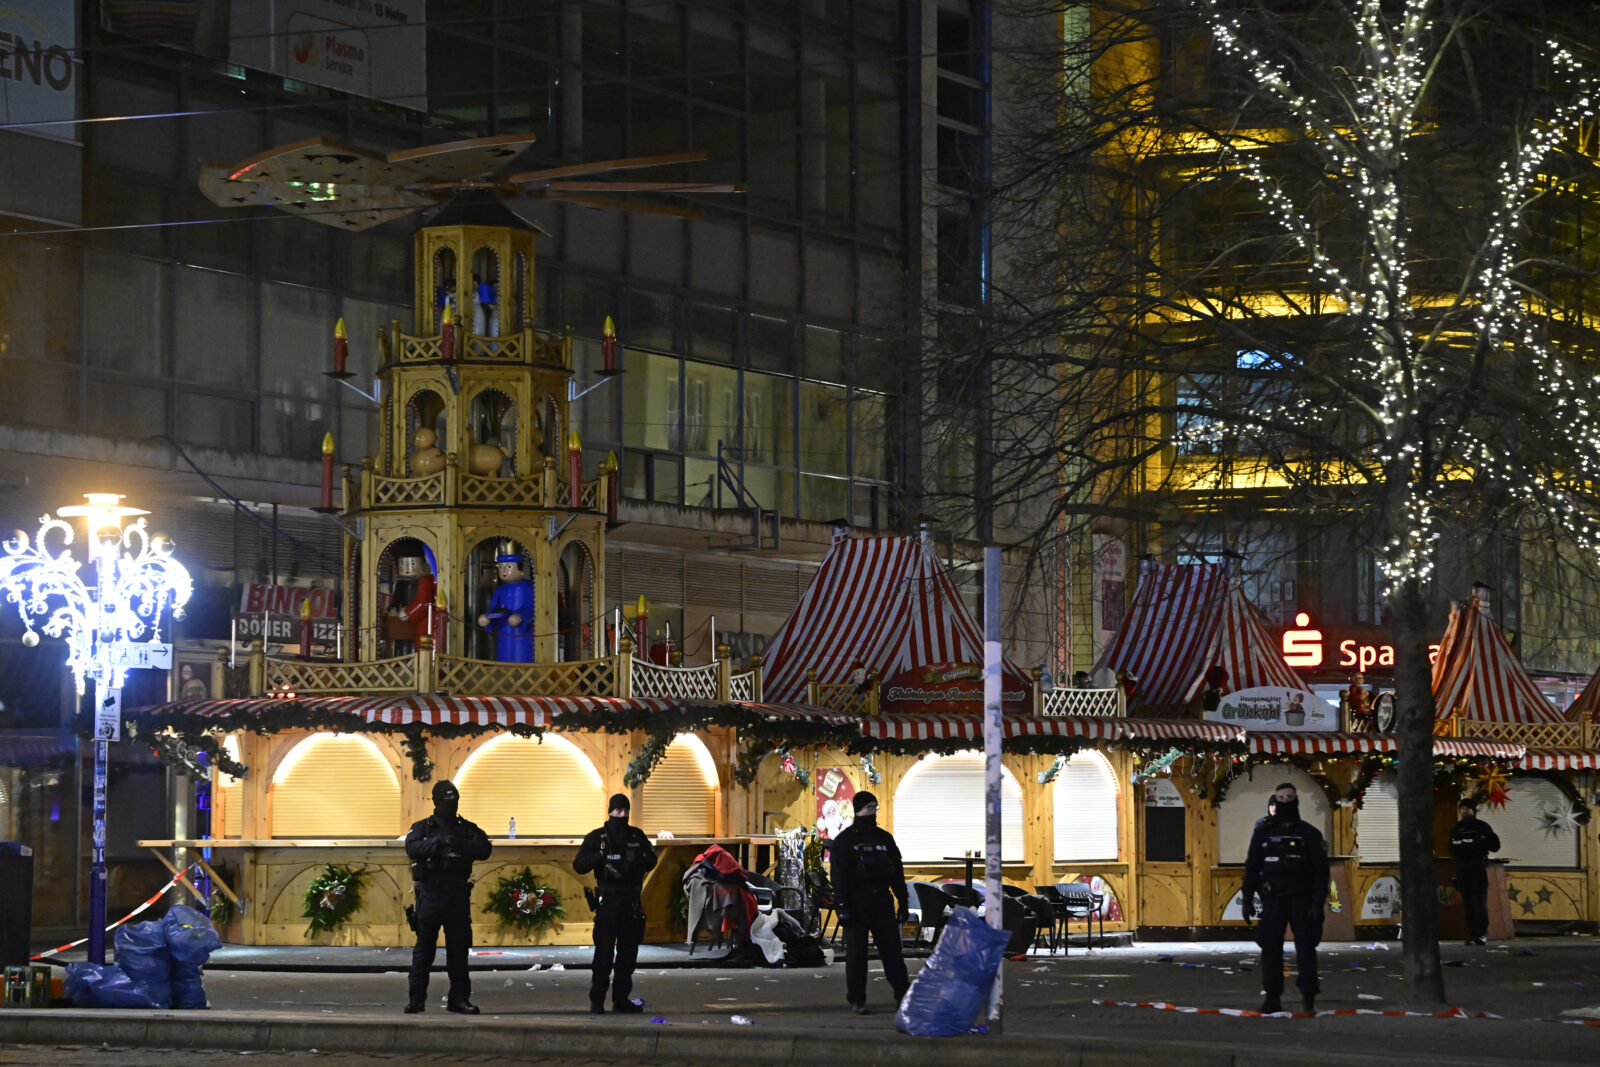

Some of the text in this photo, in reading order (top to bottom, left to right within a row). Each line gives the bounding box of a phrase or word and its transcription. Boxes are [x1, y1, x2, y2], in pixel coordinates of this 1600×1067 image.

[325, 36, 364, 62] Plasma
[325, 56, 353, 76] Service
[1222, 702, 1281, 720] Grünkohl
